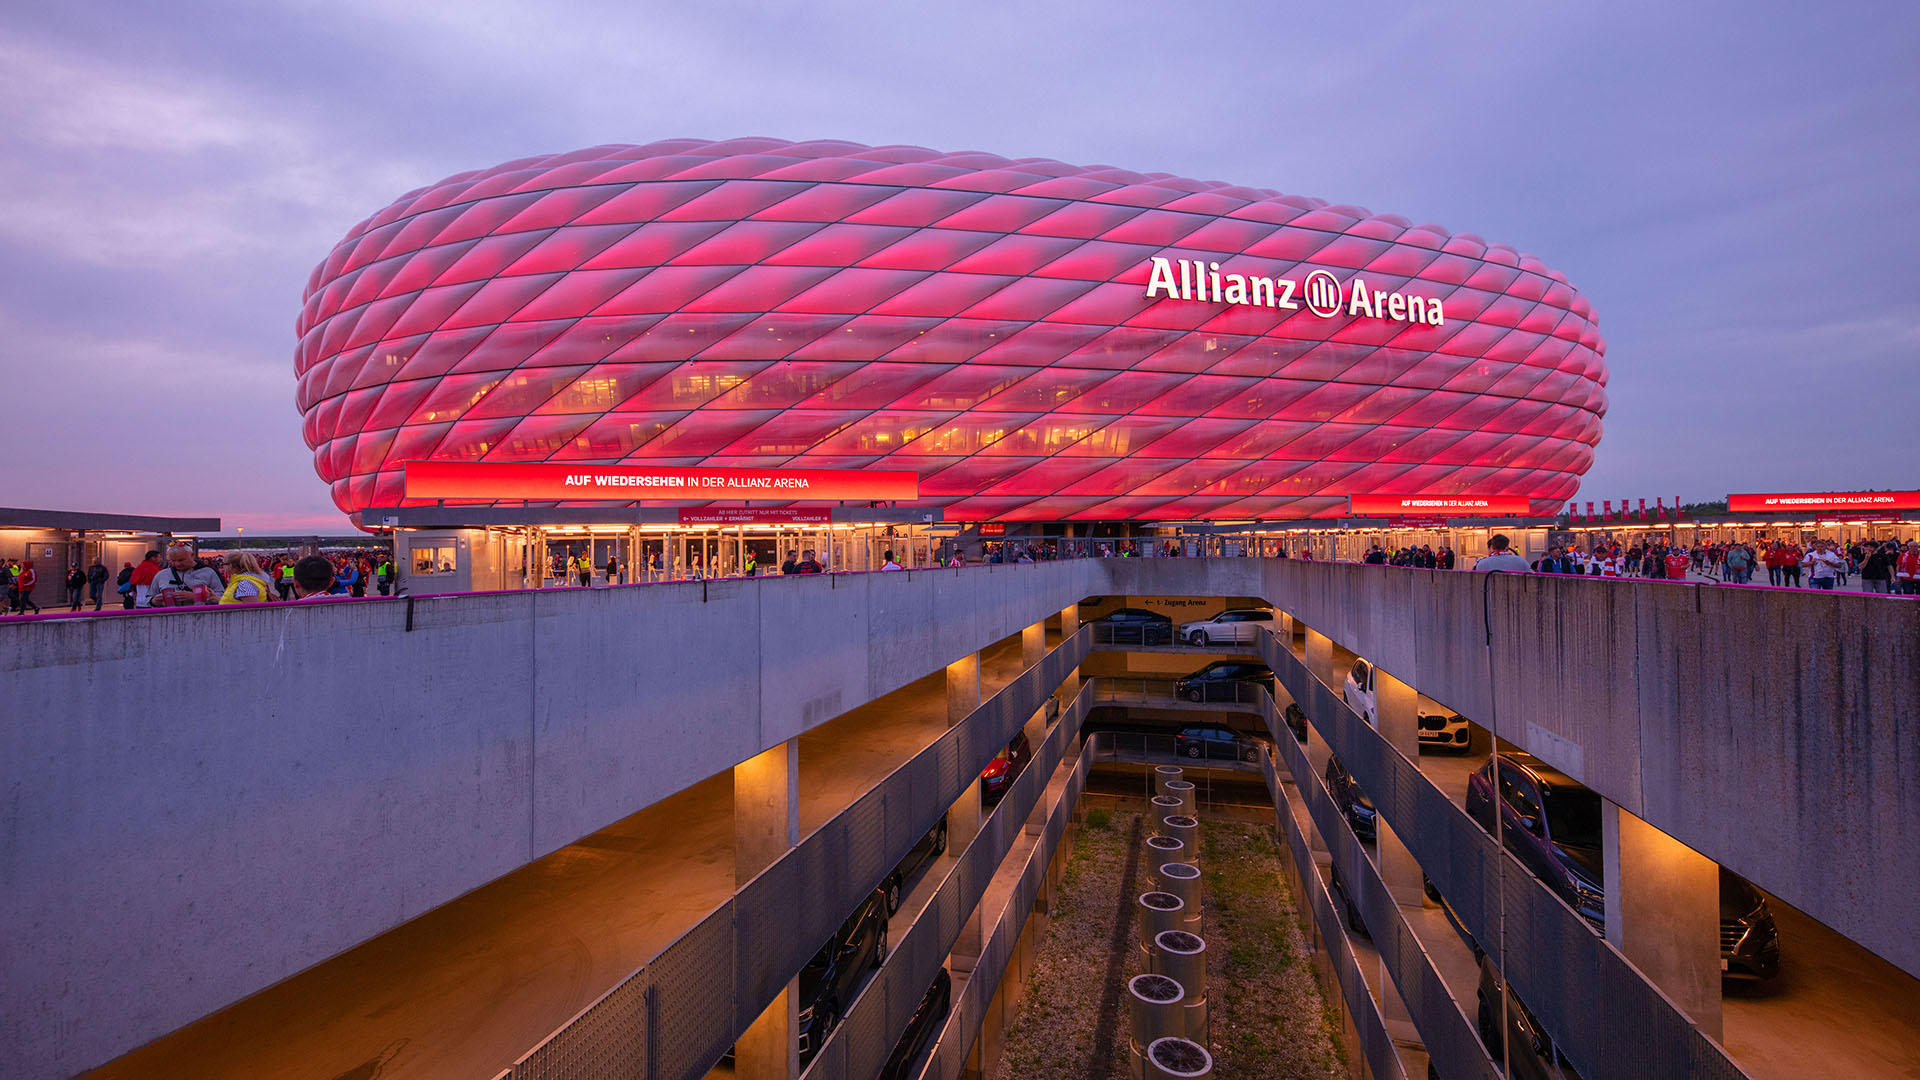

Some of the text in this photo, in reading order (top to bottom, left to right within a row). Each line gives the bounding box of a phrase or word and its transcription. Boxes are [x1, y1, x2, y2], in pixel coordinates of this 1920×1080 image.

[1146, 256, 1444, 326] Allianz Arena
[565, 475, 810, 488] AUF WIEDERSEHEN IN DER ALLIANZ ARENA
[1164, 599, 1187, 607] Zugang
